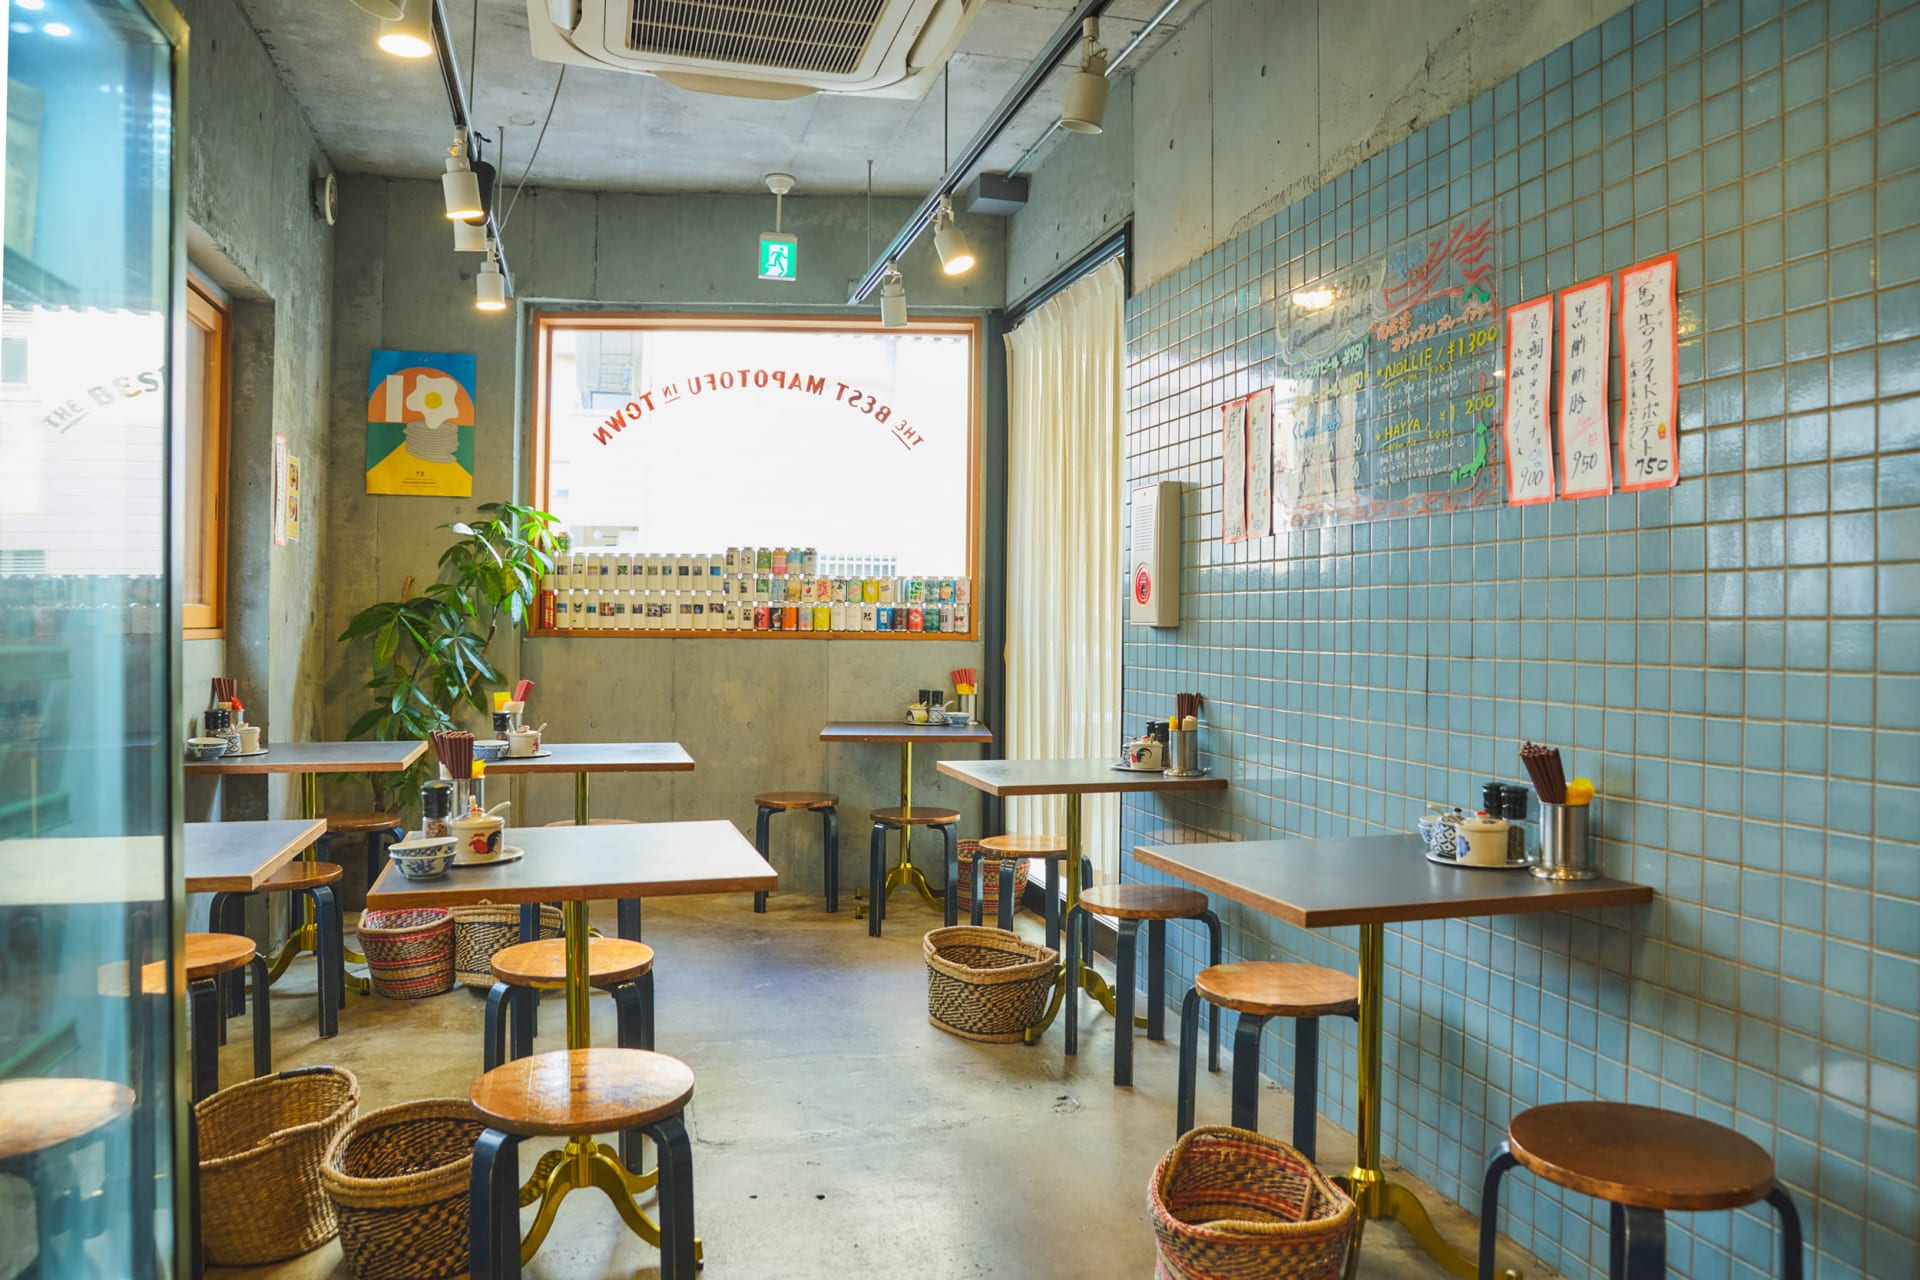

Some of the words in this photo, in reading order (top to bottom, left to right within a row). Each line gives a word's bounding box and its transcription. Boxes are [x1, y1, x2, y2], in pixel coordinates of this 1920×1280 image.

[1385, 347, 1433, 379] NOLLIE
[43, 400, 84, 428] THE
[1385, 418, 1422, 441] HAYYA
[1572, 450, 1598, 480] 950
[1635, 457, 1668, 477] 750
[1520, 466, 1544, 493] 900
